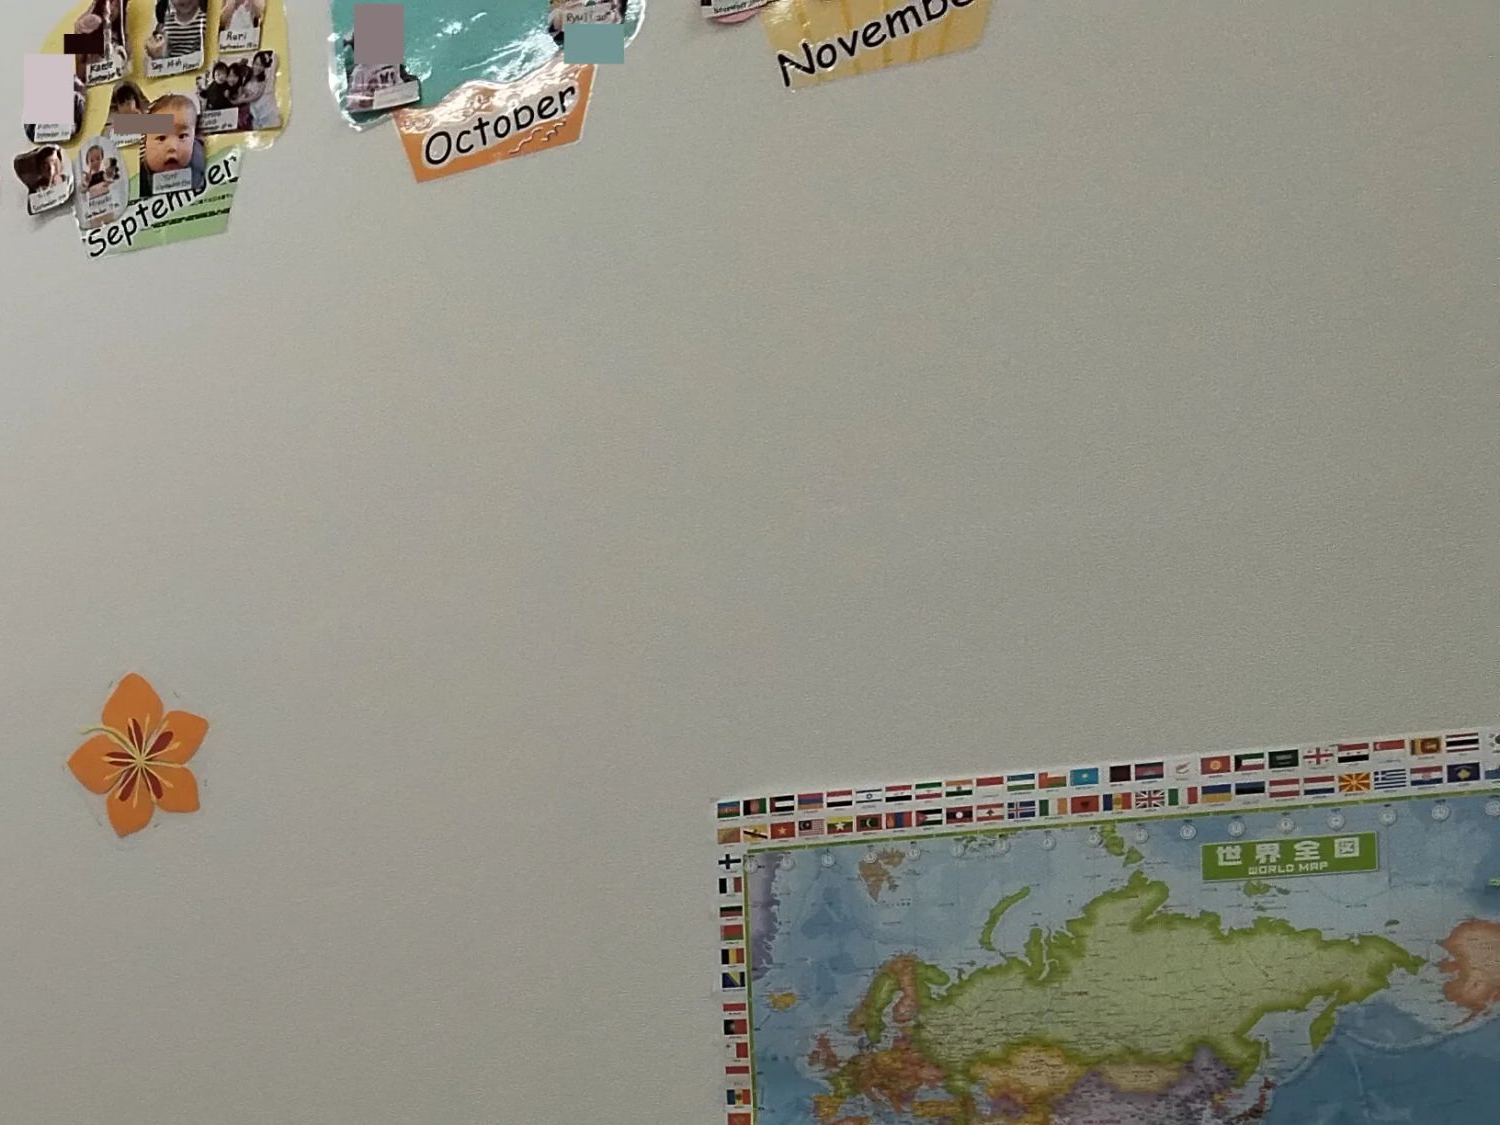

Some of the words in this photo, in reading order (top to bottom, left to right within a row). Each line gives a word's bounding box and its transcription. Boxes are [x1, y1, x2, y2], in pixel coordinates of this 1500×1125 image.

[777, 0, 976, 88] Novemb
[425, 85, 576, 166] October
[1216, 837, 1360, 866] 世界全図
[1248, 864, 1295, 876] WORLD
[1299, 861, 1329, 872] MAP
